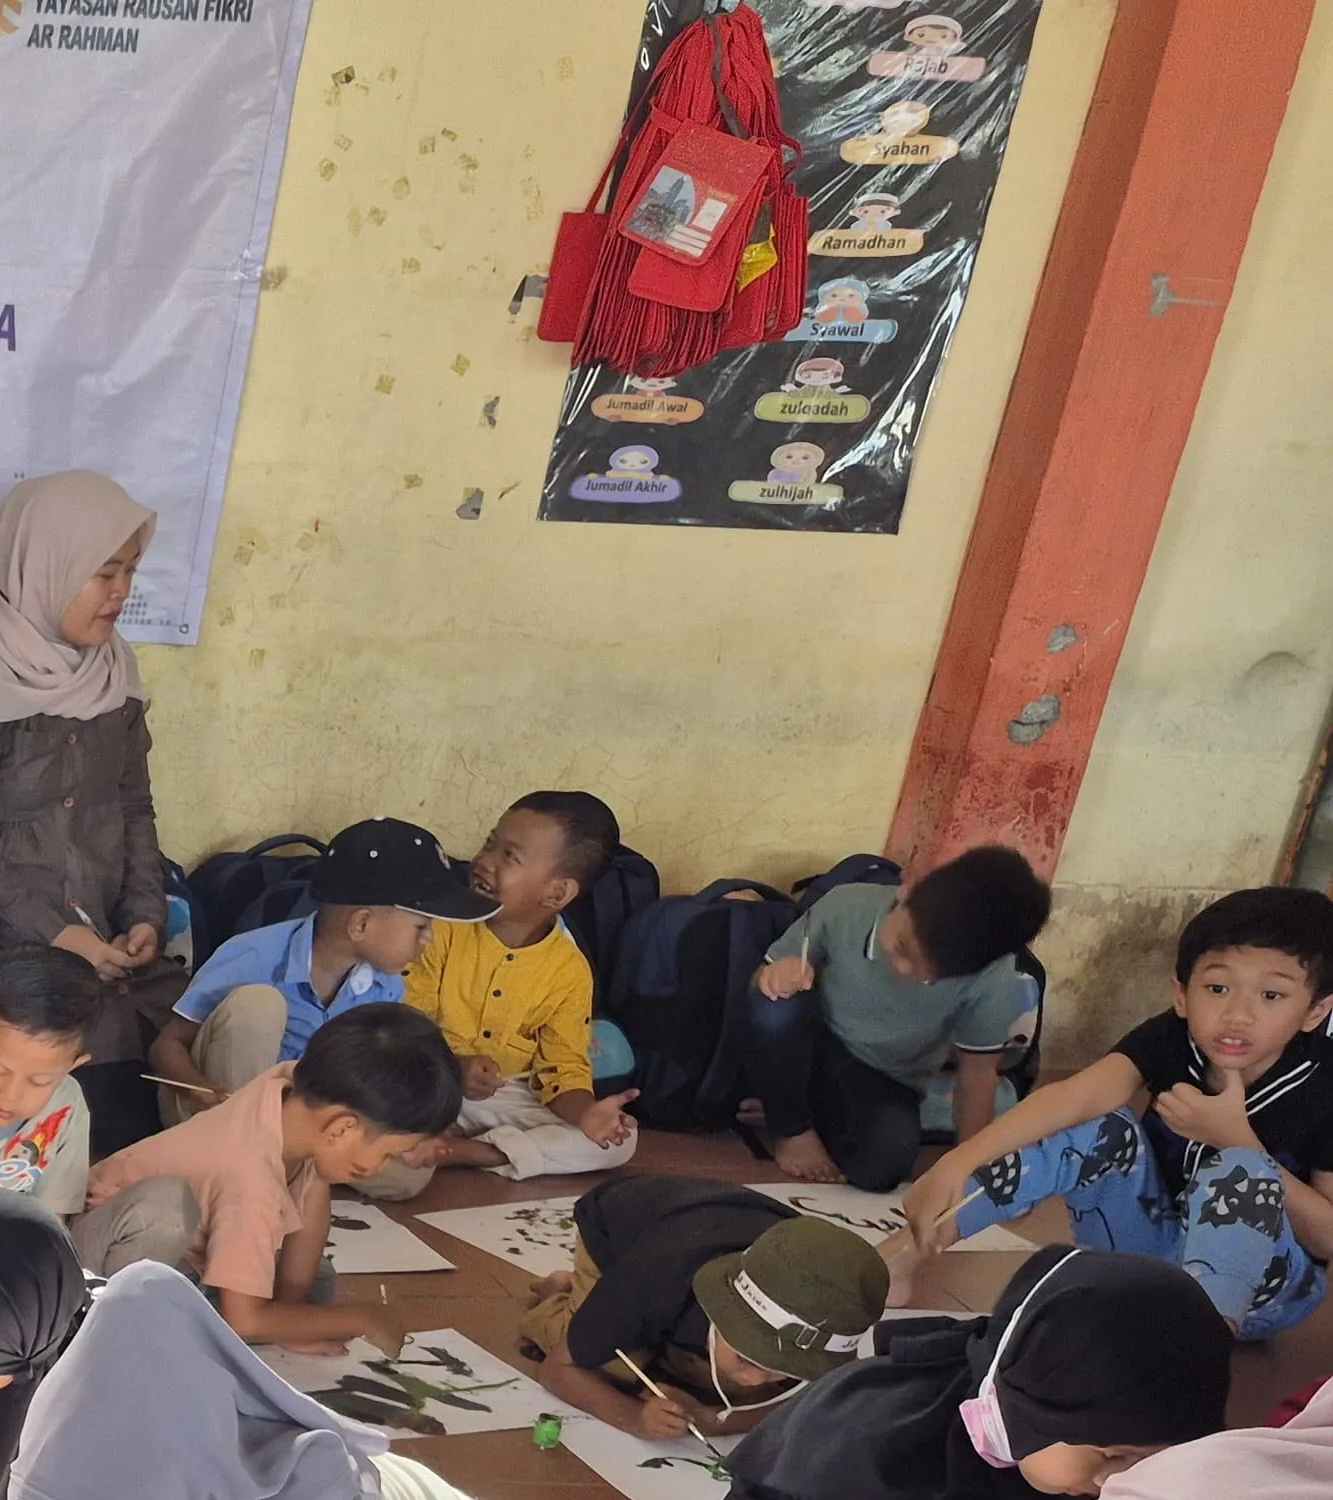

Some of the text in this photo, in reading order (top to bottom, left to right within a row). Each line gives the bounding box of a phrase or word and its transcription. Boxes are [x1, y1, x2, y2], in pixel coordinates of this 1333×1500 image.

[203, 0, 253, 22] FIKRI
[27, 24, 139, 53] AR RAHMAN
[874, 140, 931, 159] Syaban
[822, 234, 907, 251] Ramadhan
[605, 398, 688, 414] Jumadil Awal
[584, 479, 669, 495] Jumadil Akhir
[759, 485, 815, 503] zulhijah
